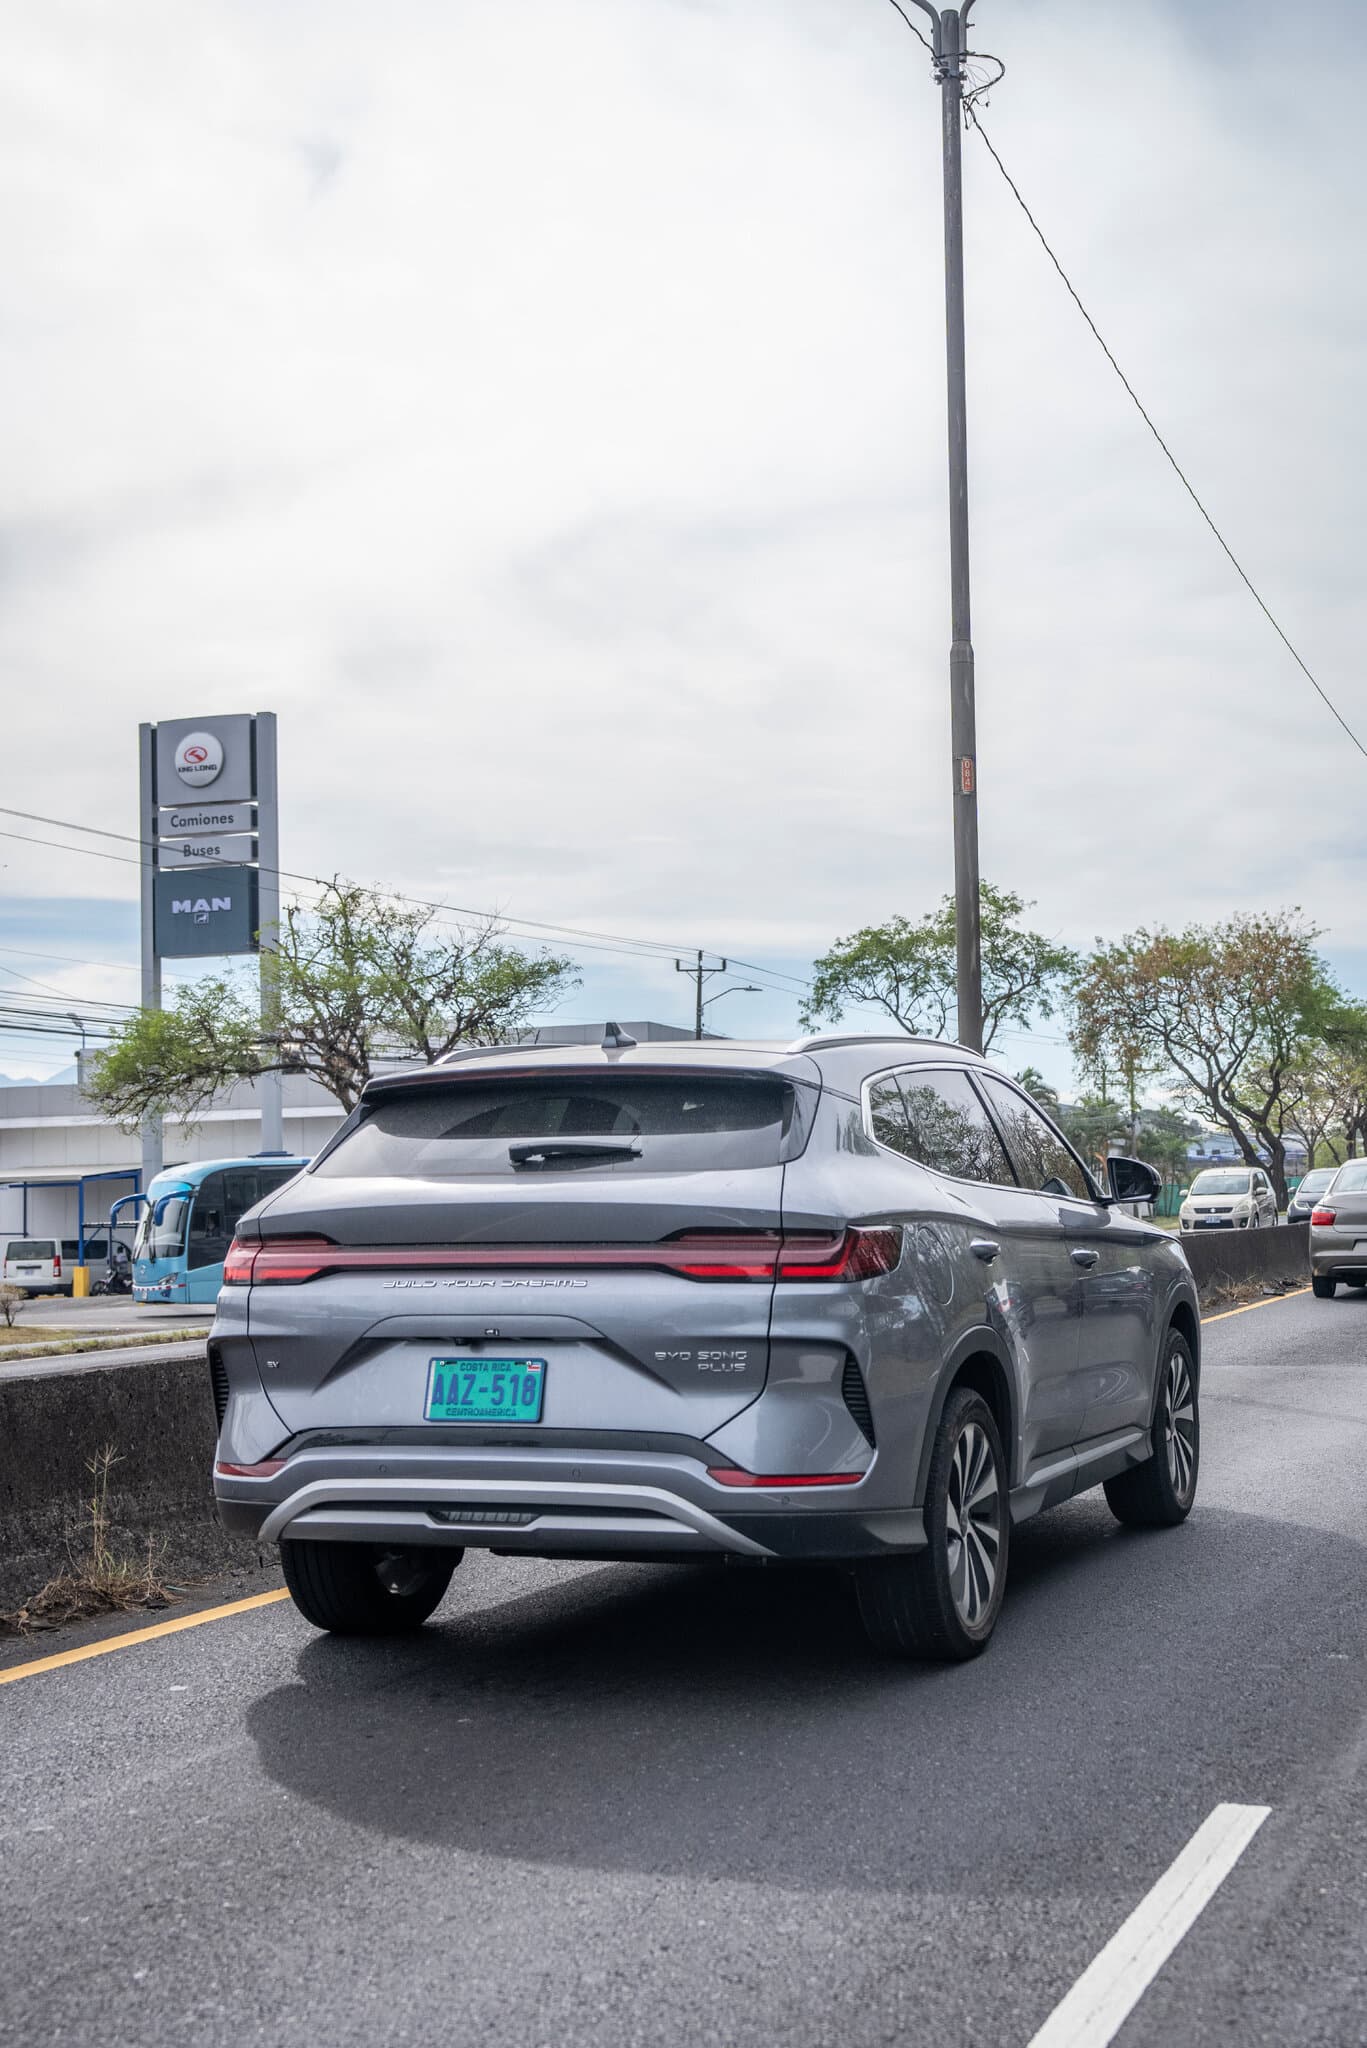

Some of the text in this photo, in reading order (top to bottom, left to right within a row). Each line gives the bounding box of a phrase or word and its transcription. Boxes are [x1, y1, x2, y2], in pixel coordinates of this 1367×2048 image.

[194, 764, 218, 772] LONG
[170, 813, 235, 828] Camiones
[183, 844, 221, 857] Buses
[172, 897, 231, 914] MAN
[383, 1279, 588, 1289] BUILD YOUR DREAMS
[654, 1351, 748, 1361] BYD SONG
[460, 1362, 511, 1372] COSTA RICA
[697, 1363, 746, 1372] PLUS
[431, 1373, 536, 1406] AAZ-518
[446, 1407, 516, 1417] CENTROAMERICA
